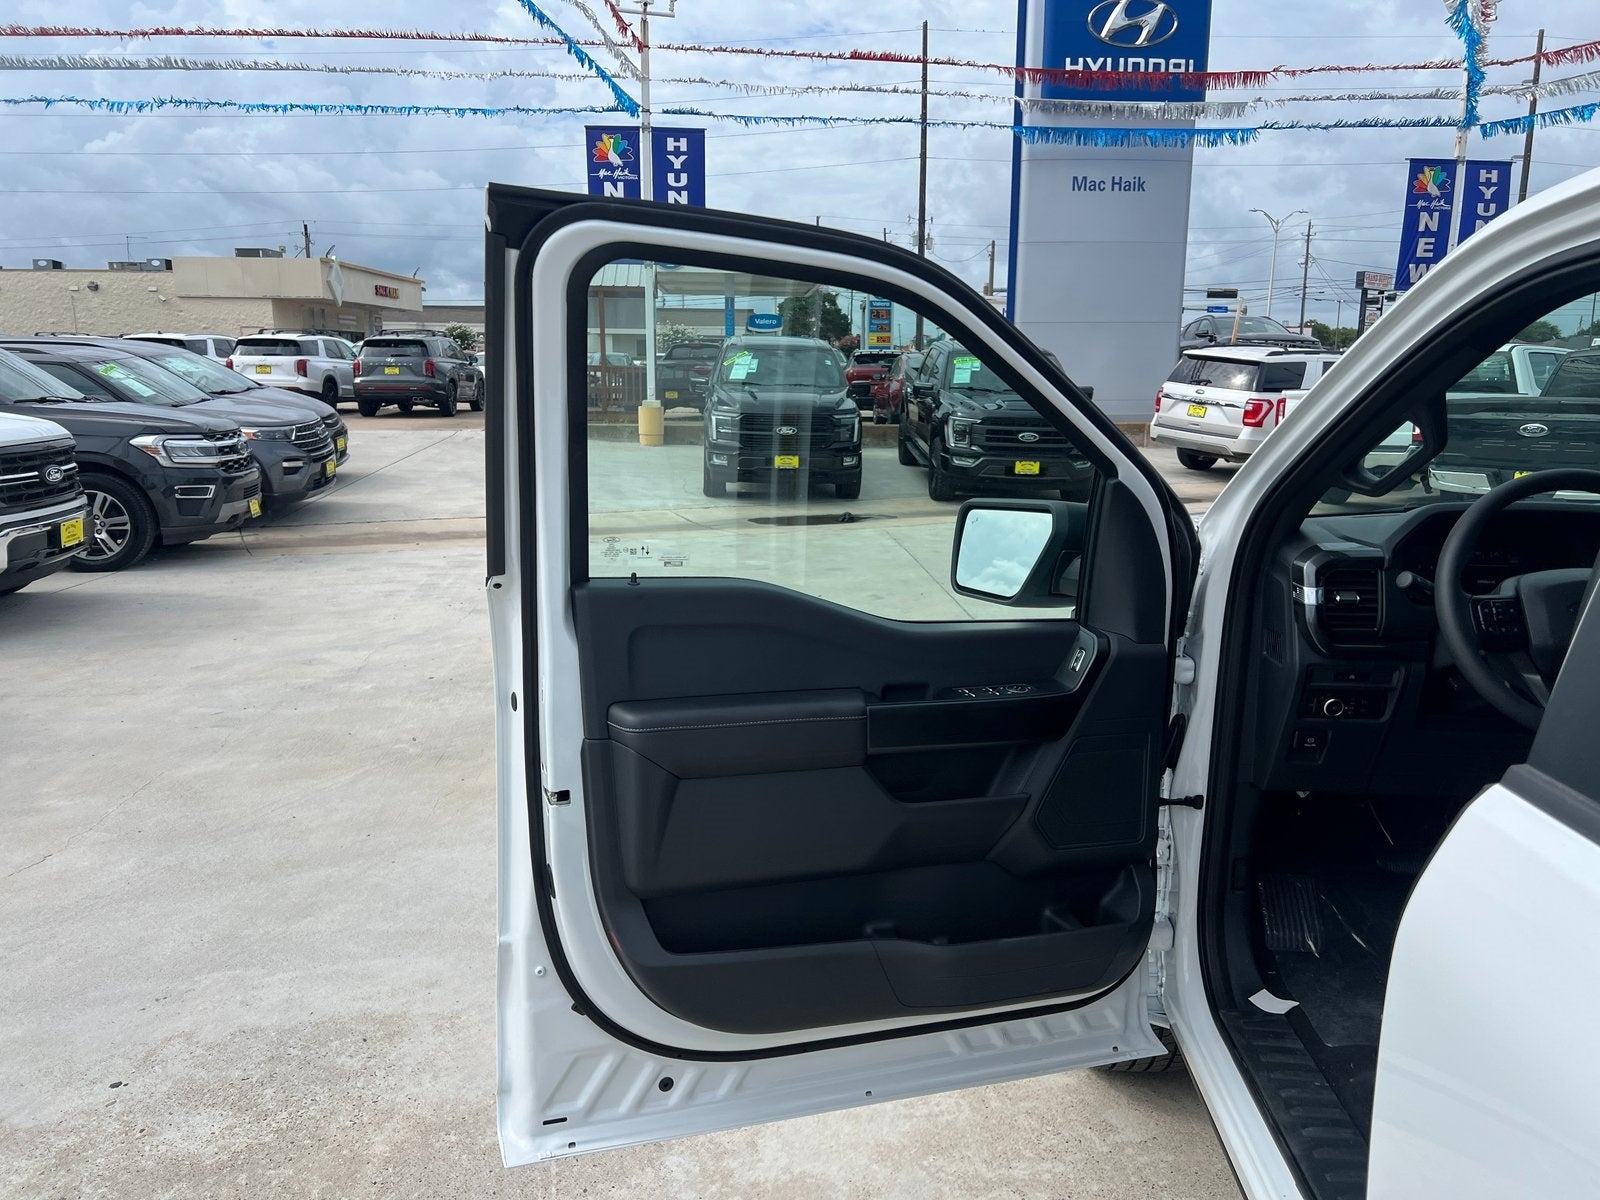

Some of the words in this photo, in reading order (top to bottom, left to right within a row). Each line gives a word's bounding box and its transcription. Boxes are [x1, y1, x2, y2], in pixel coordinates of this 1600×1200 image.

[1065, 57, 1194, 73] HYUNDAI
[1072, 176, 1106, 192] Mac
[1111, 175, 1146, 193] Haik
